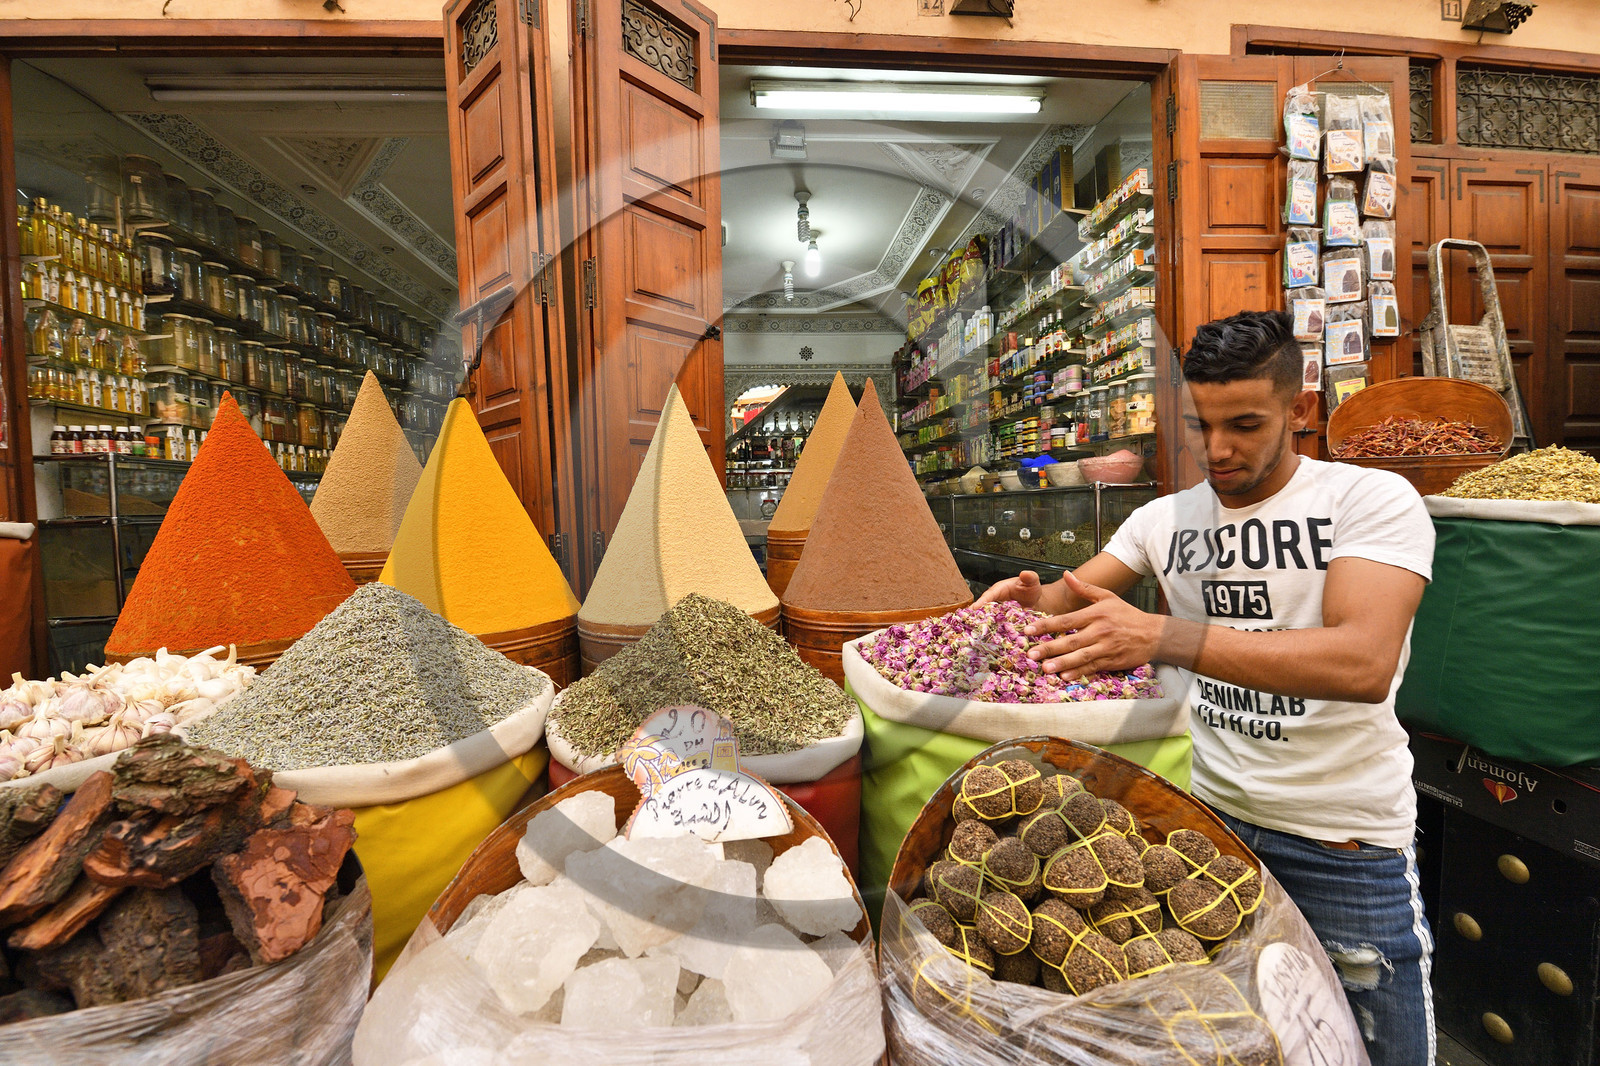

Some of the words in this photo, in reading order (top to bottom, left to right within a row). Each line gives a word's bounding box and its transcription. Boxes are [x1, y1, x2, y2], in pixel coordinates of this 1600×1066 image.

[1445, 2, 1459, 17] 11
[1204, 584, 1268, 617] 1975
[1197, 678, 1306, 717] DENIMLAB
[1467, 756, 1539, 792] Ajoman
